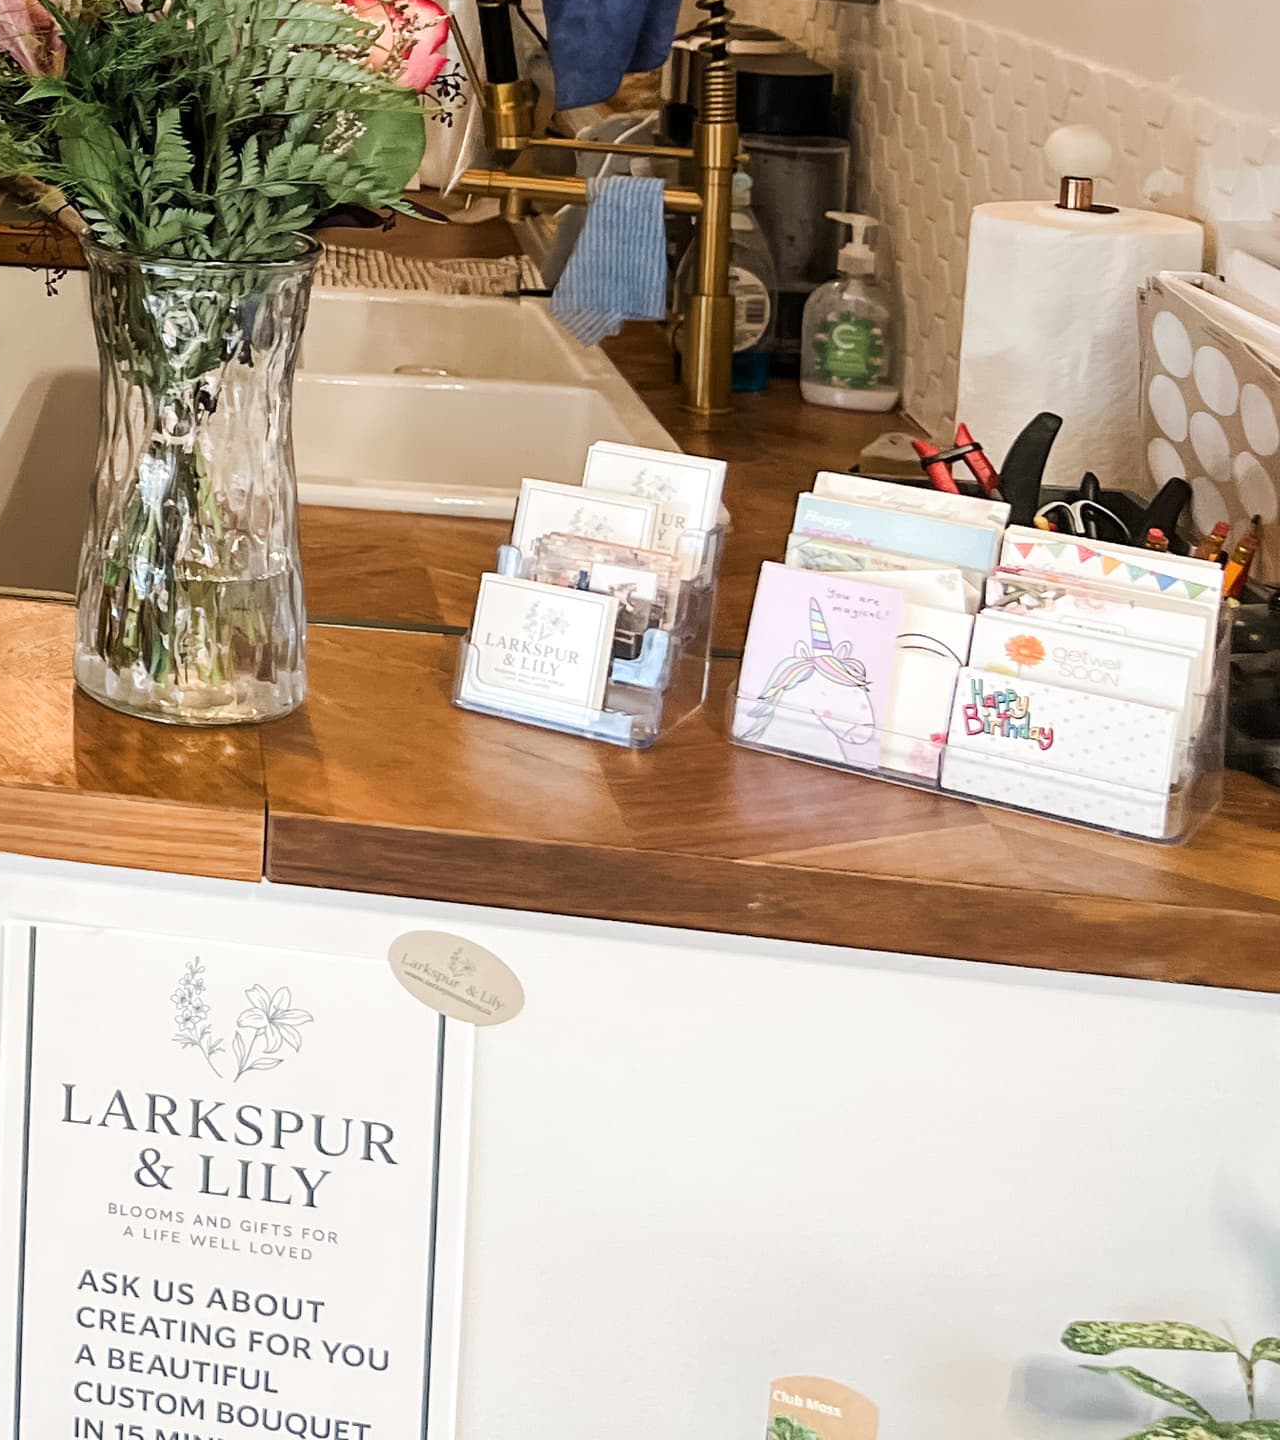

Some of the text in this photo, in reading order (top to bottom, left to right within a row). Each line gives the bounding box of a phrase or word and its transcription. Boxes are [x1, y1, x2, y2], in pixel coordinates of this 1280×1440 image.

[485, 632, 579, 664] LARKSPUR
[503, 653, 560, 677] & LILY
[970, 679, 1029, 719] Happy
[963, 704, 1054, 750] Birthday
[401, 952, 460, 988] Larkspur
[465, 985, 479, 997] &
[480, 991, 504, 1010] Lily
[61, 1083, 399, 1165] LARKSPUR
[134, 1148, 333, 1209] & LILY
[108, 1203, 338, 1245] BLOOMS AND GIFTS FOR
[123, 1226, 313, 1261] A LIFE WELL LOVED
[77, 1269, 324, 1323] ASK US ABOUT
[76, 1306, 390, 1371] CREATING FOR YOU
[74, 1343, 279, 1394] A BEAUTIFUL
[74, 1381, 371, 1440] CUSTOM BOUQUET
[773, 1389, 842, 1417] Club Moss
[74, 1416, 104, 1440] IN
[114, 1423, 144, 1440] 15
